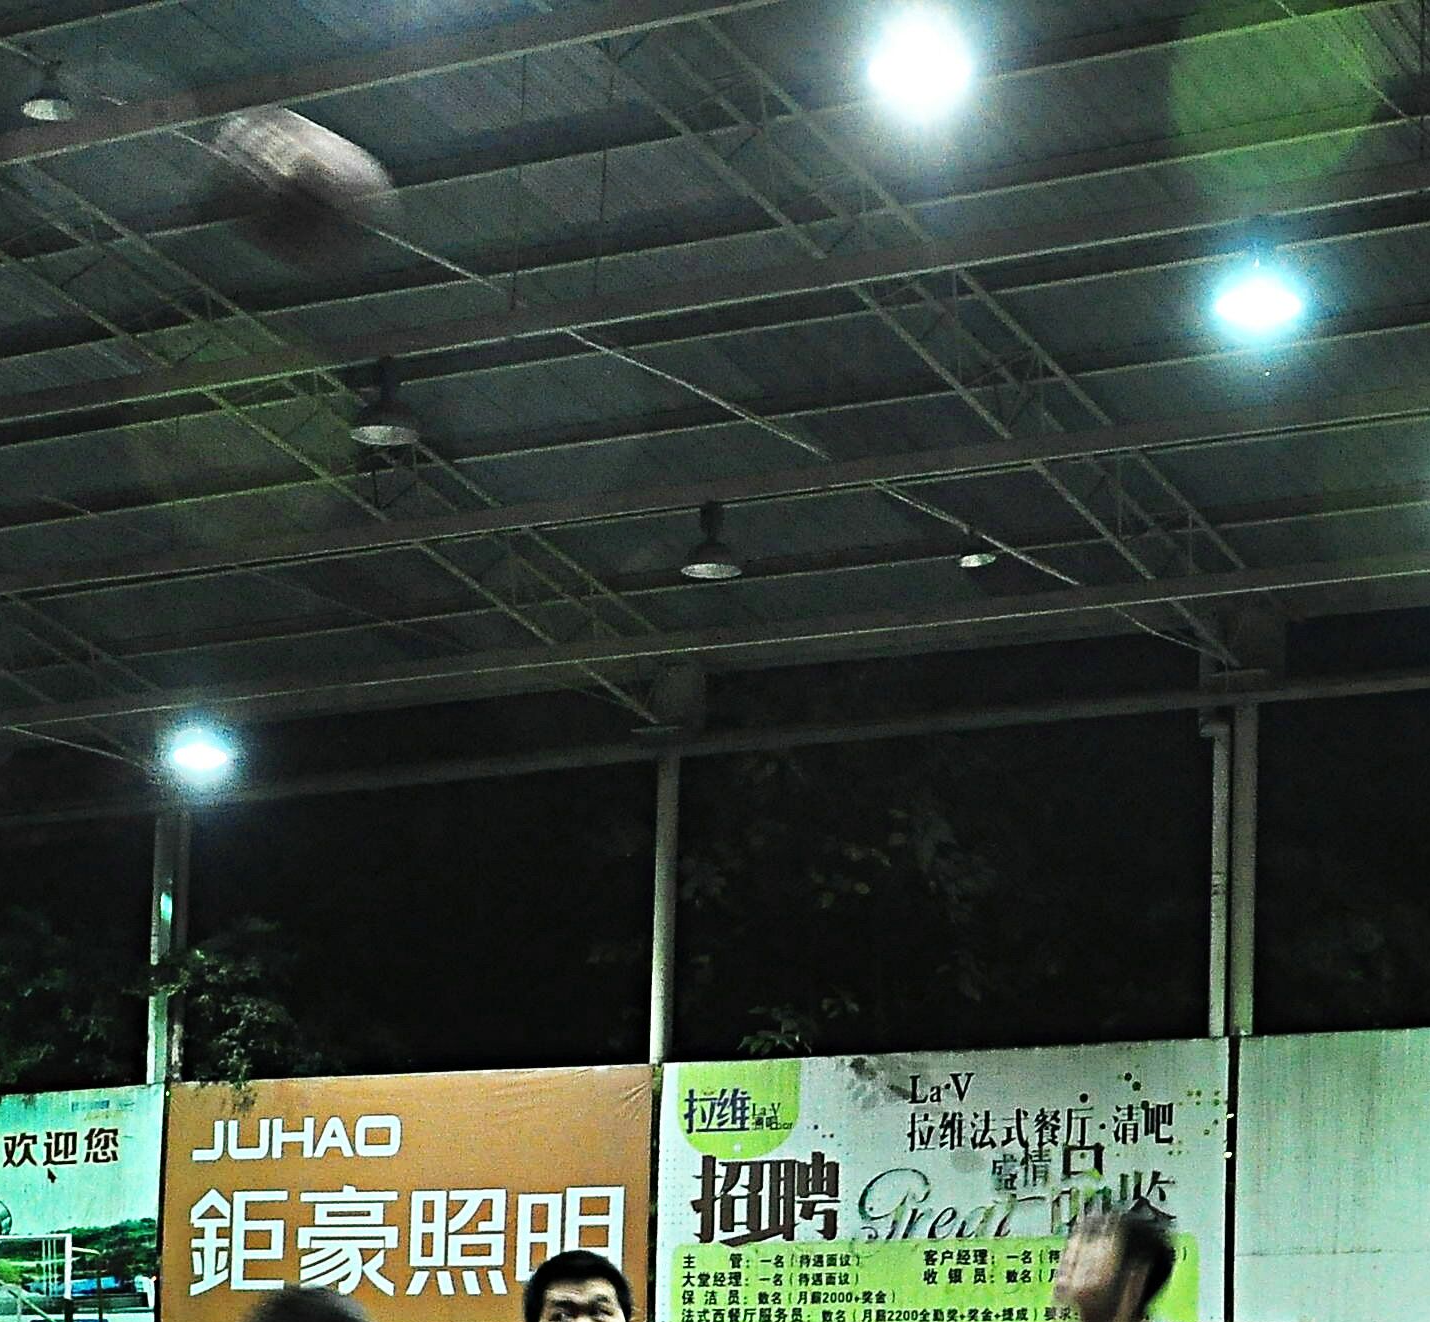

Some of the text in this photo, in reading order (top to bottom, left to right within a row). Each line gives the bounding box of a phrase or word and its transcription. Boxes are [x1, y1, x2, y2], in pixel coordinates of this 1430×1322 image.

[684, 1088, 751, 1134] 拉维
[191, 1113, 401, 1162] JUHAO
[691, 1152, 840, 1248] 招聘
